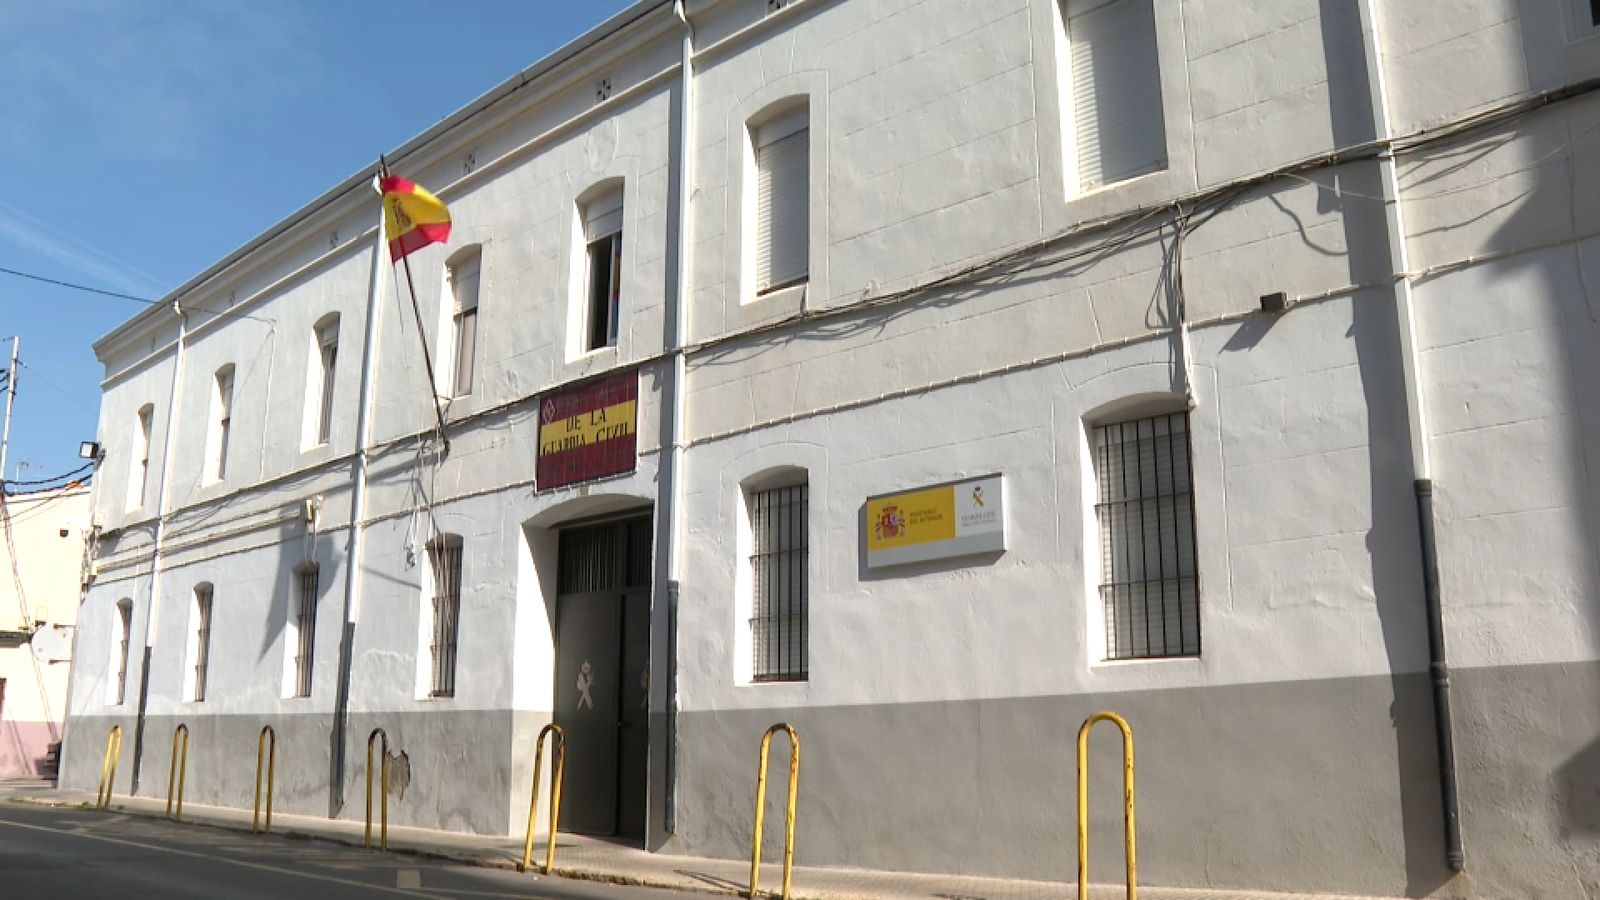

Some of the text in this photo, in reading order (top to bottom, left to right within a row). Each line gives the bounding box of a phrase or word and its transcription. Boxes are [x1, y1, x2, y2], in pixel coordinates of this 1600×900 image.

[566, 407, 606, 432] DE LA
[543, 422, 627, 456] GUARDIA CIVIL
